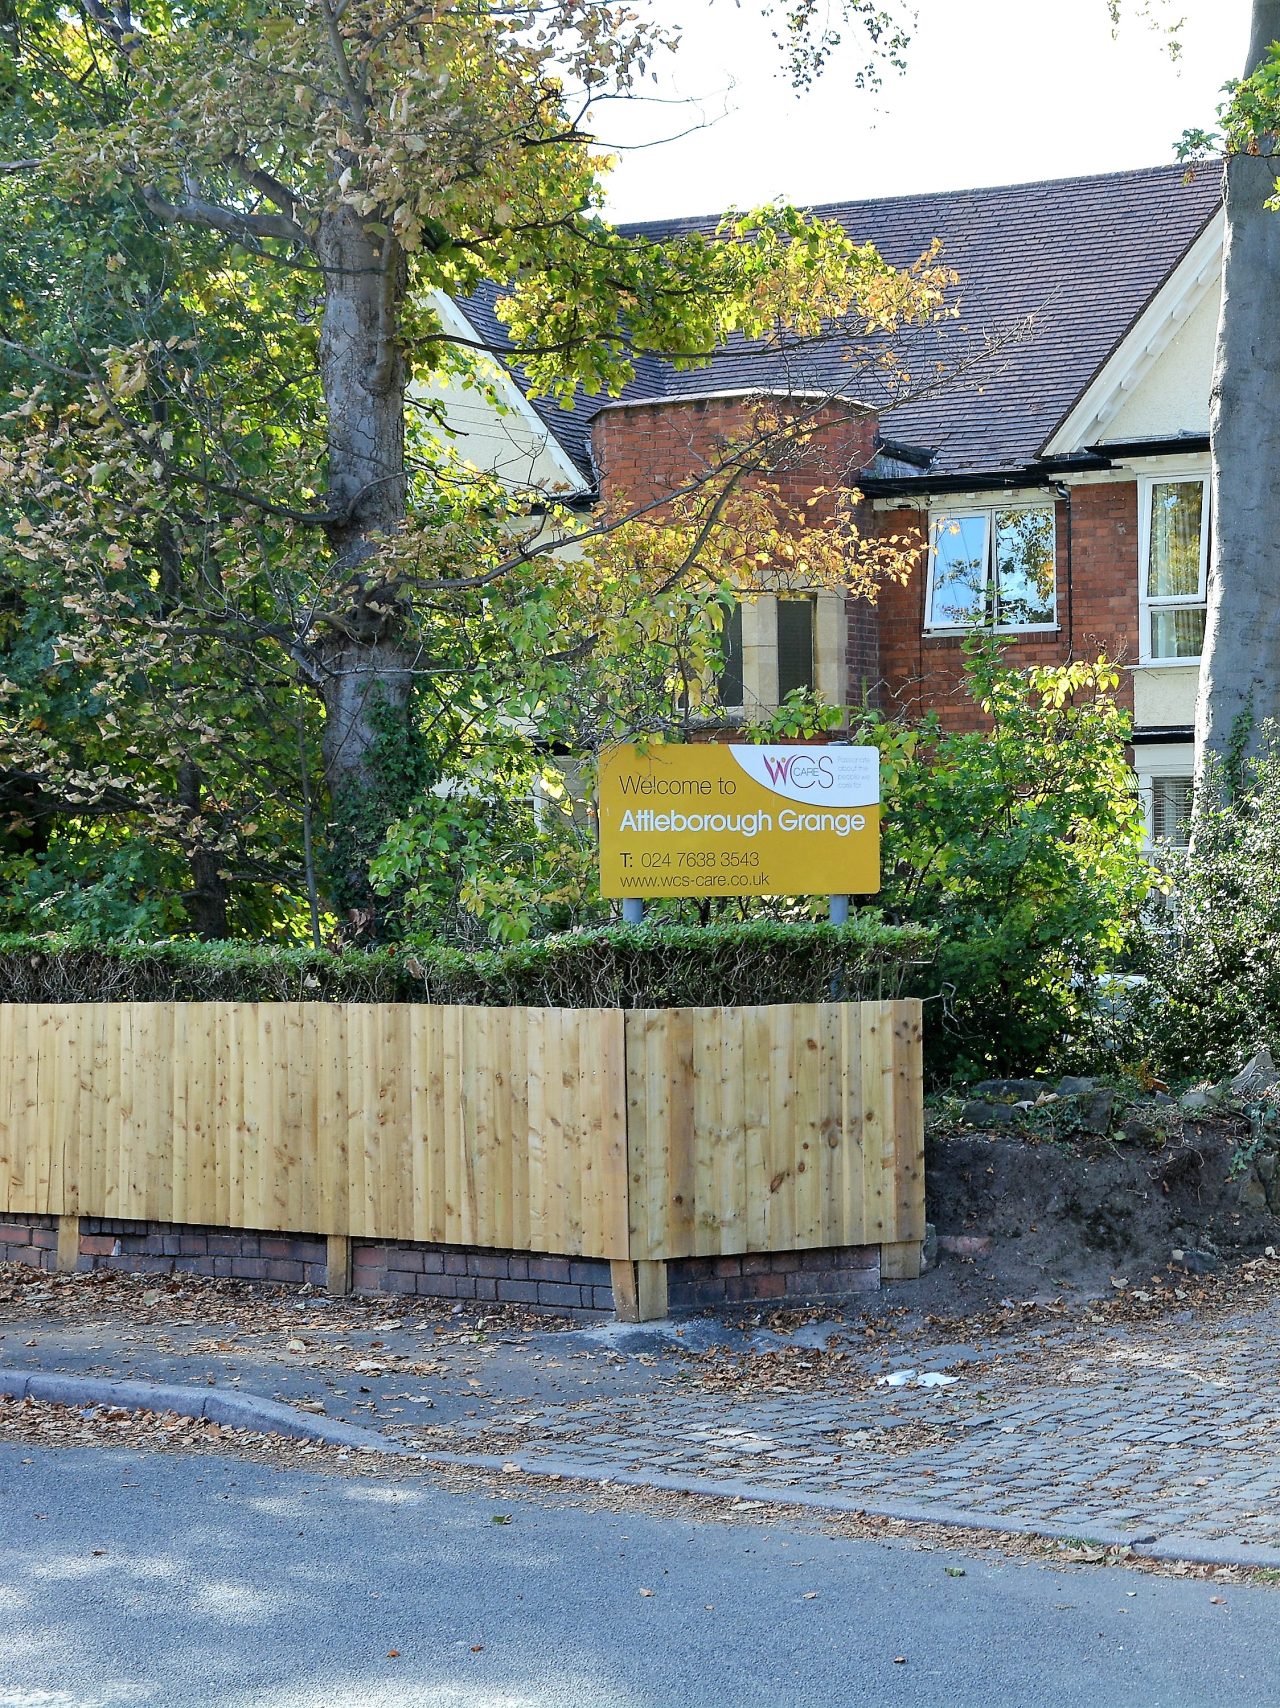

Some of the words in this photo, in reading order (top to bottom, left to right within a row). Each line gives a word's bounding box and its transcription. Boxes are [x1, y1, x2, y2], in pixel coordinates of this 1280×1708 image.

[762, 754, 834, 789] WCS
[793, 767, 819, 777] CARE
[618, 775, 712, 795] Welcome
[717, 777, 737, 795] to
[619, 809, 773, 837] Attleborough
[778, 809, 866, 837] Grange
[620, 852, 633, 868] T:
[641, 852, 671, 868] 024
[677, 852, 716, 867] 7638
[720, 851, 760, 867] 3543
[620, 872, 770, 888] www.wcs-care.co.uk
